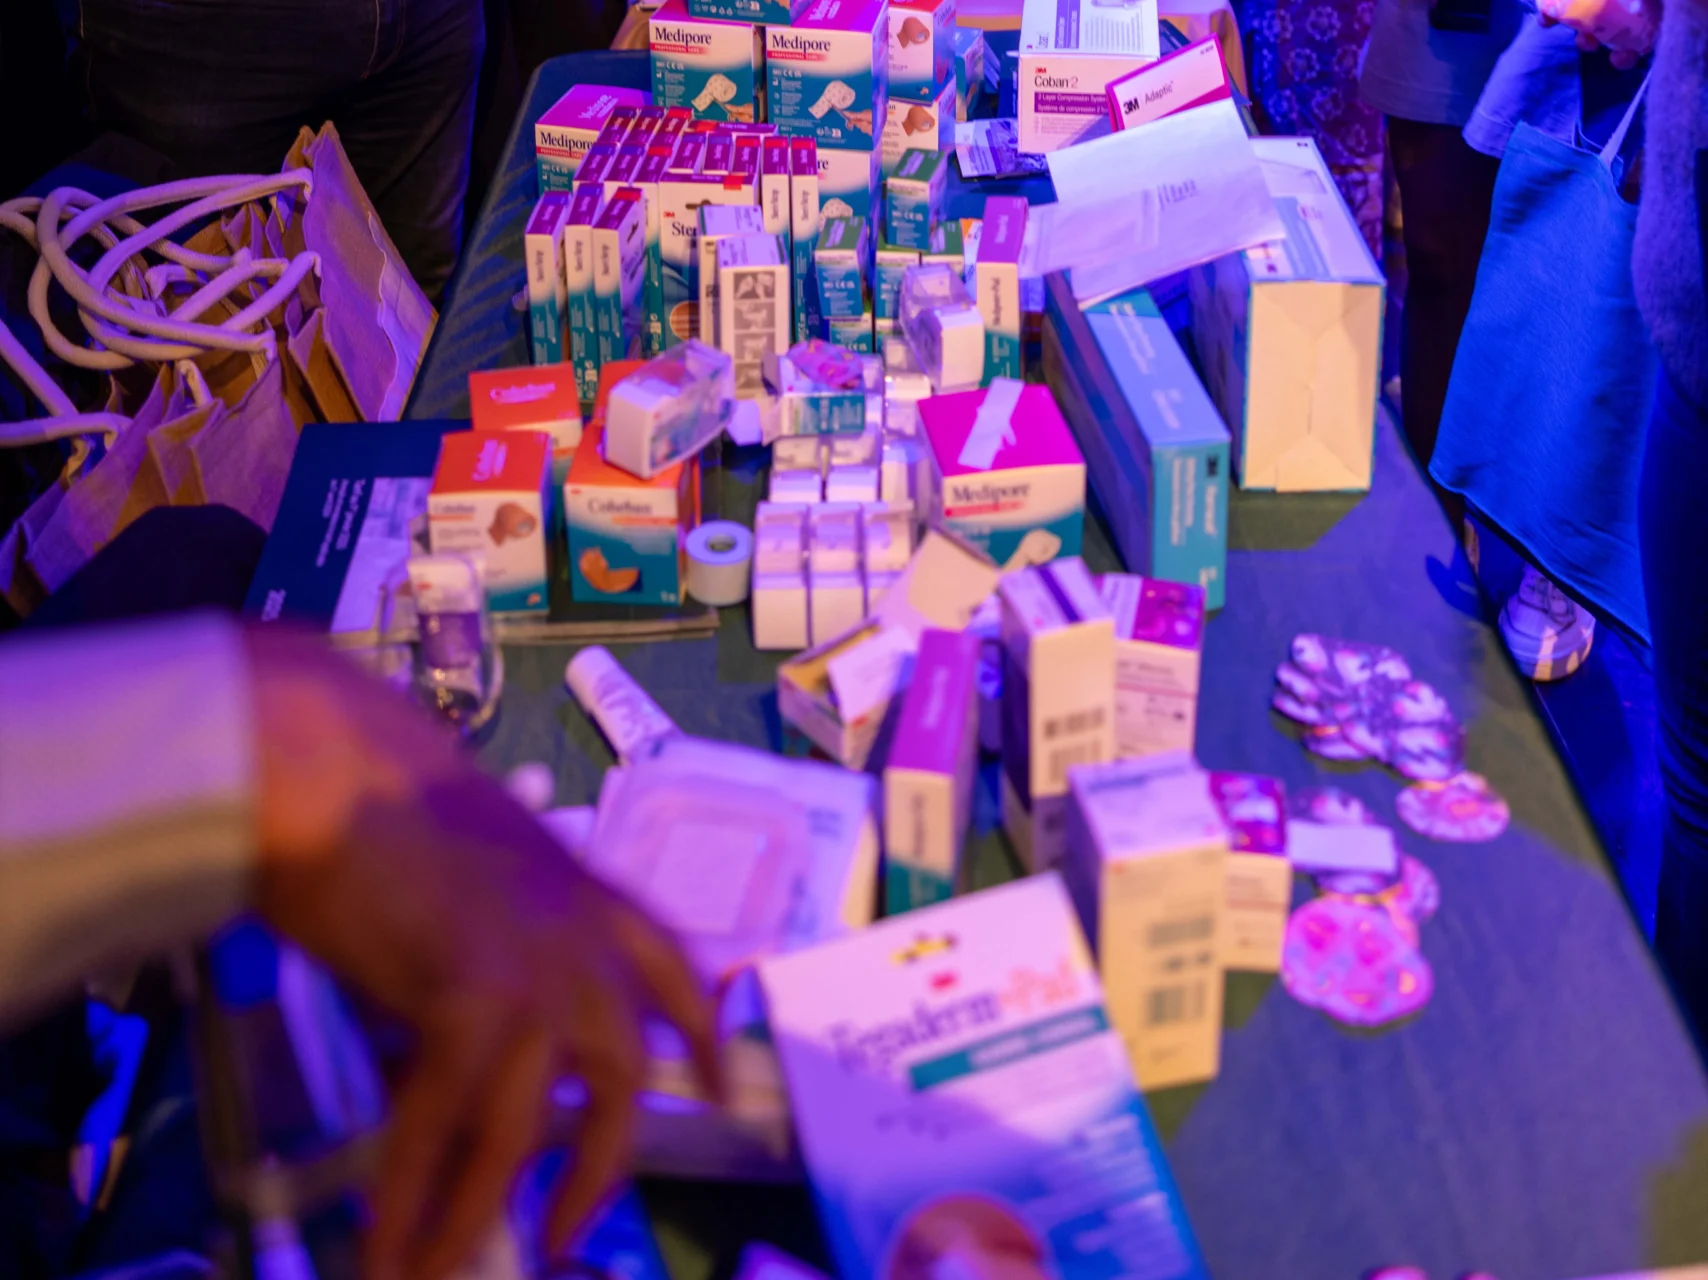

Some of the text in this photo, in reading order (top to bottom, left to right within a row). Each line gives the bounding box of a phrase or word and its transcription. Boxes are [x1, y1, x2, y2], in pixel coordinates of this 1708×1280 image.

[655, 26, 712, 46] Medipore
[772, 34, 831, 55] Medipore
[1034, 75, 1069, 88] Coban
[1123, 97, 1140, 115] 3M
[540, 131, 593, 151] Medipore
